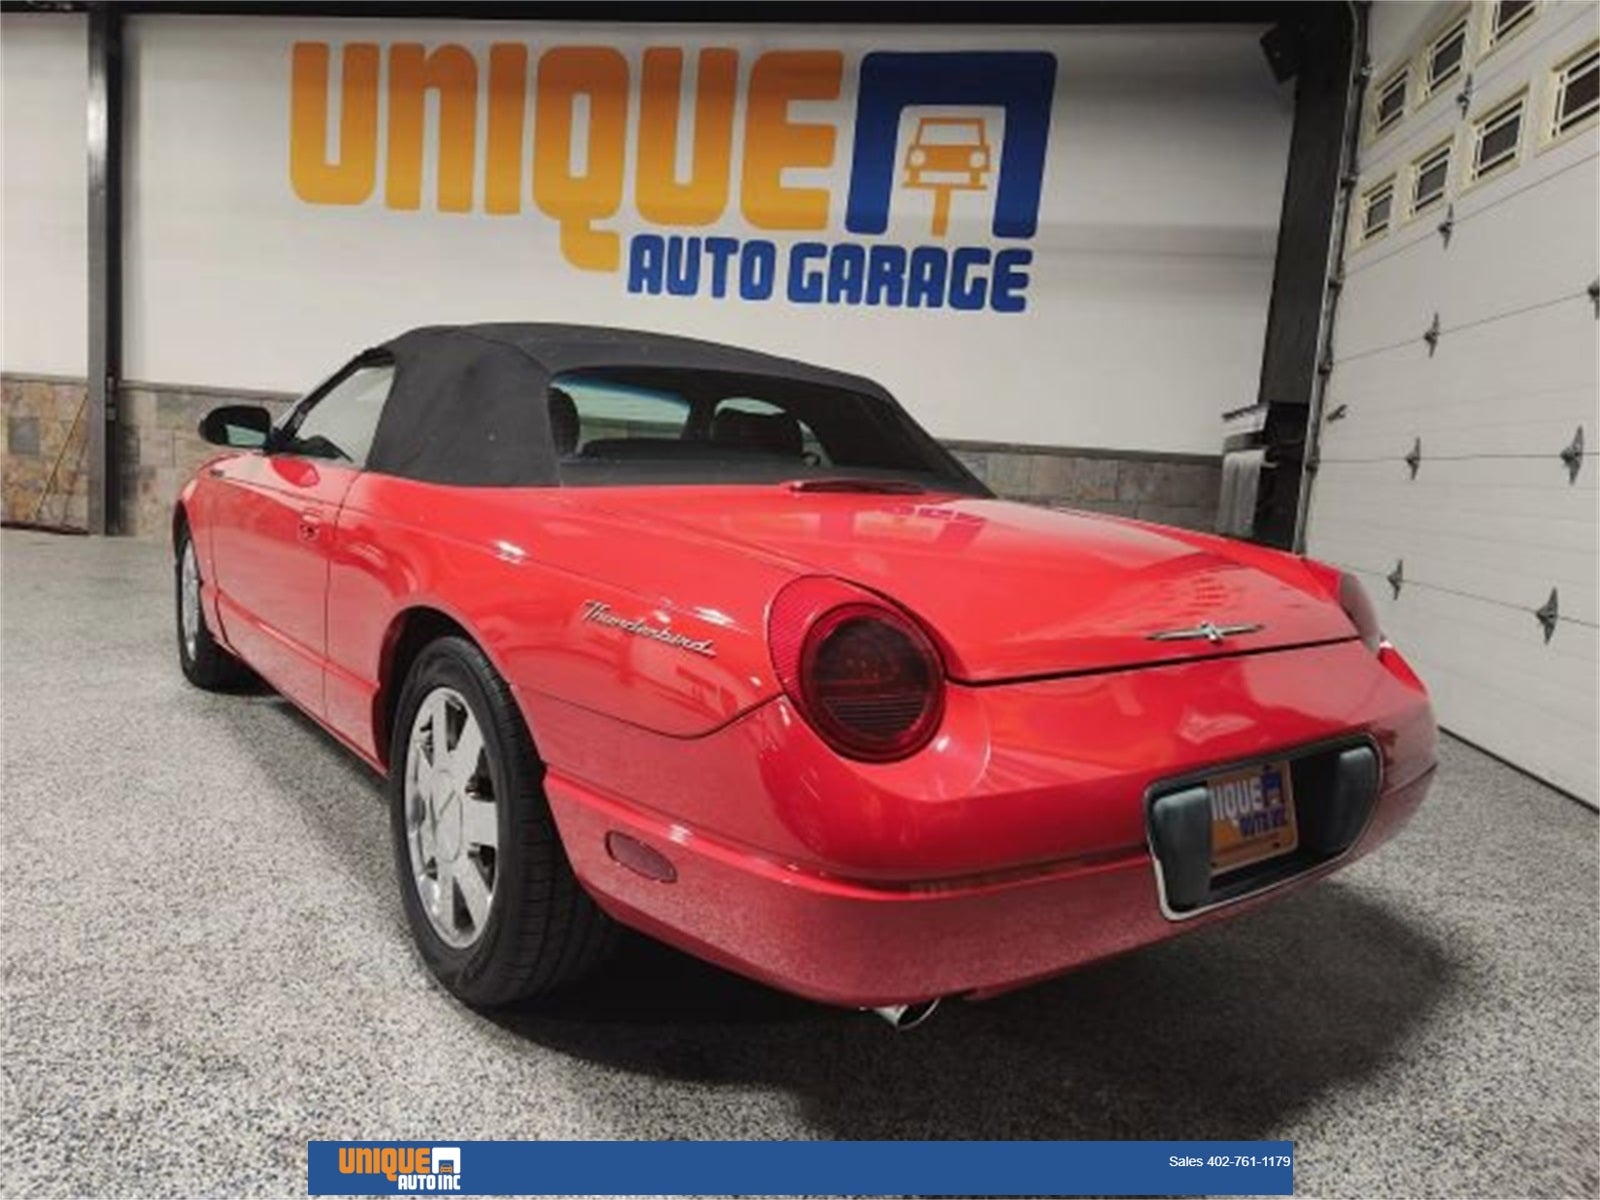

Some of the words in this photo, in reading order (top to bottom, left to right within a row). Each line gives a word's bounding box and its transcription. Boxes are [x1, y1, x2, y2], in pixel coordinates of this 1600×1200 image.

[290, 41, 845, 271] UNIQUE
[626, 234, 776, 302] AUTO
[786, 240, 1033, 313] GARAGE
[582, 599, 717, 658] Thunderbird
